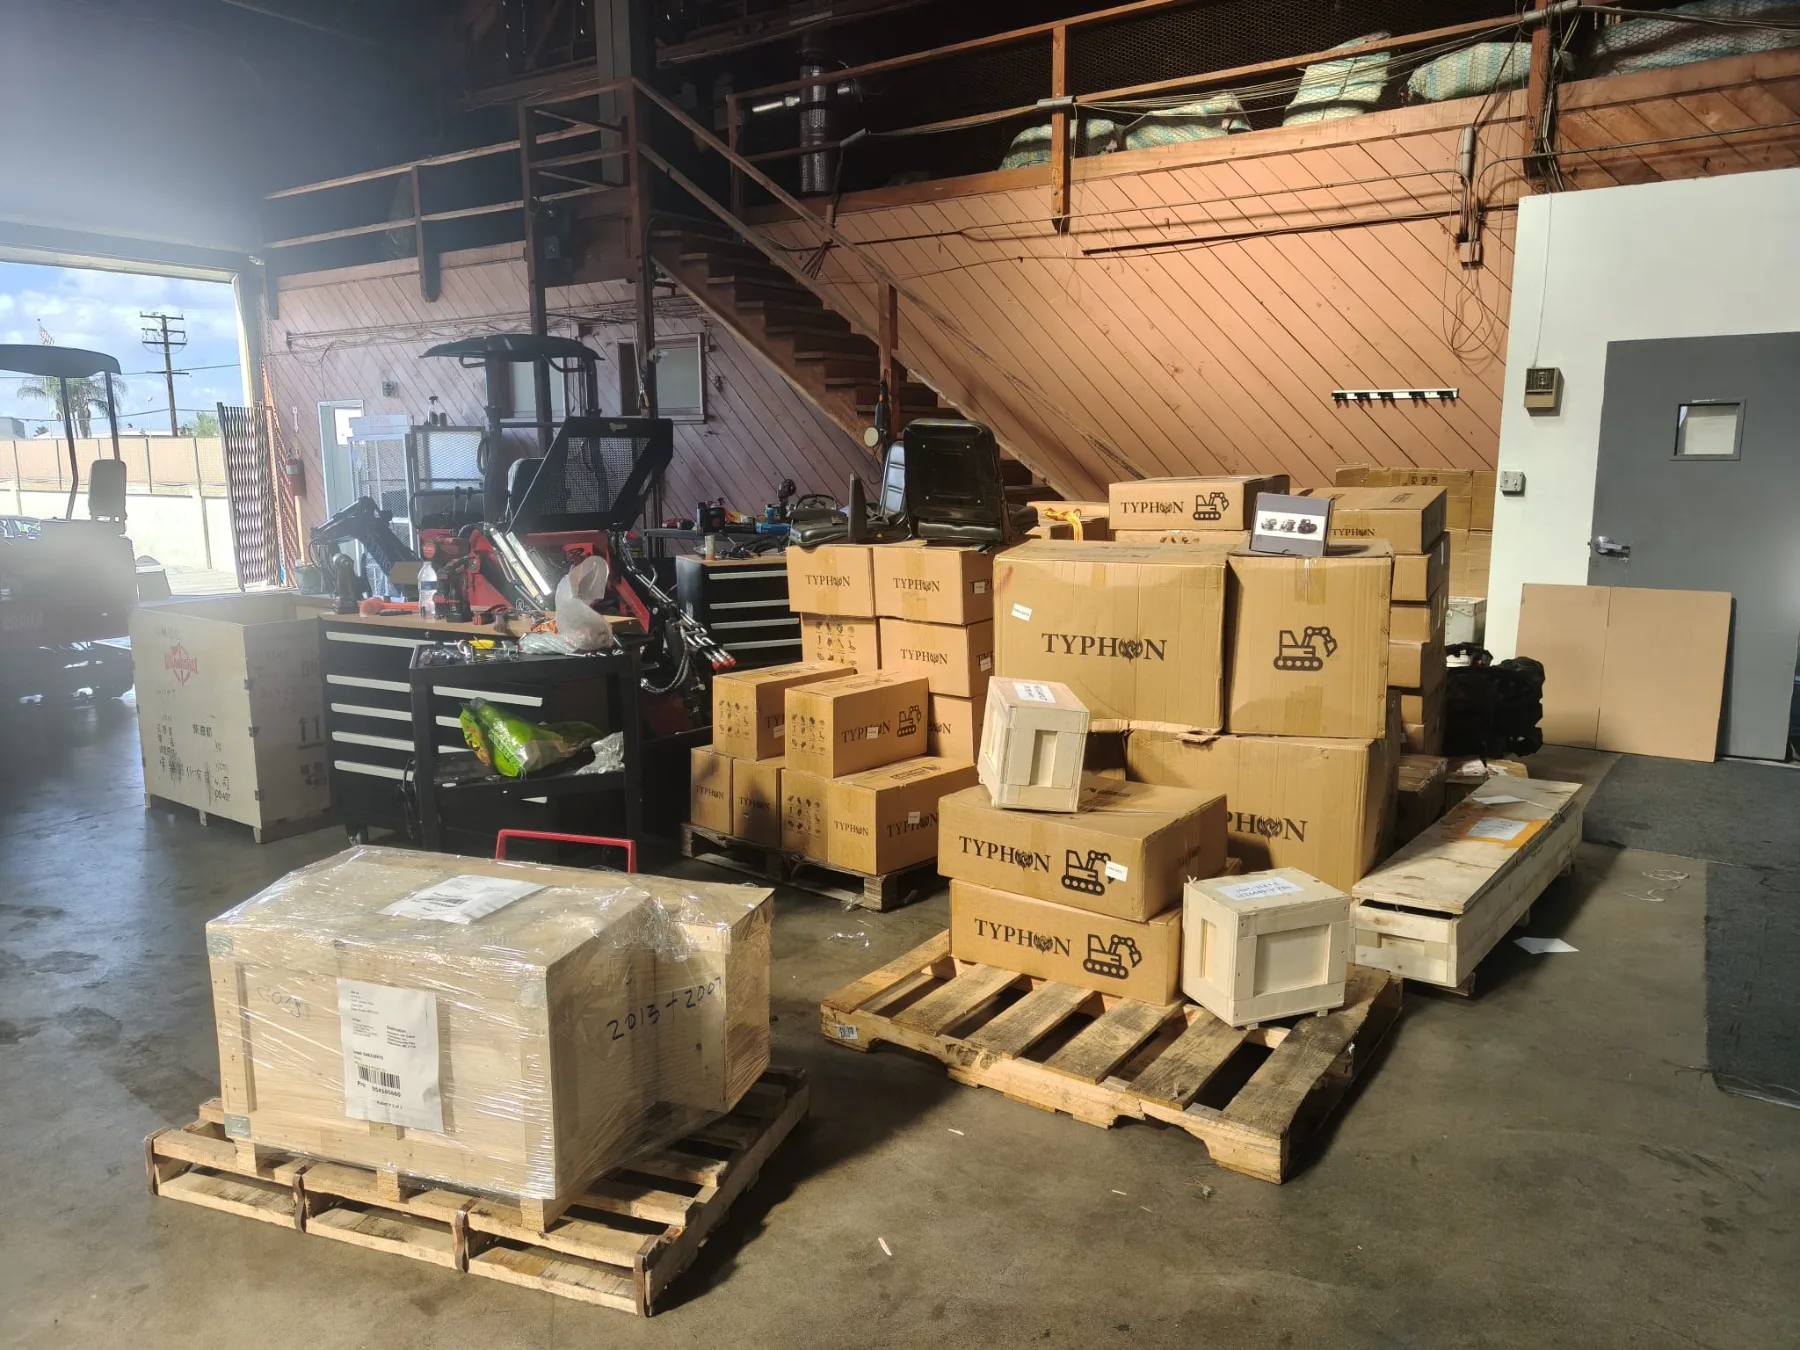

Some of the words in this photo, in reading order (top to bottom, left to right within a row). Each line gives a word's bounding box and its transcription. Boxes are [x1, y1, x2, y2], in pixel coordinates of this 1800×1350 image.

[1120, 501, 1185, 515] TYPHON
[805, 575, 851, 588] TYPHON
[892, 577, 940, 593] TYPHON
[1041, 632, 1168, 663] TYPHON
[900, 648, 948, 664] TYPHON
[833, 820, 869, 836] TYPHON
[958, 835, 1051, 873] TYPHON
[974, 918, 1072, 957] TYPHON
[606, 1003, 660, 1041] 2013
